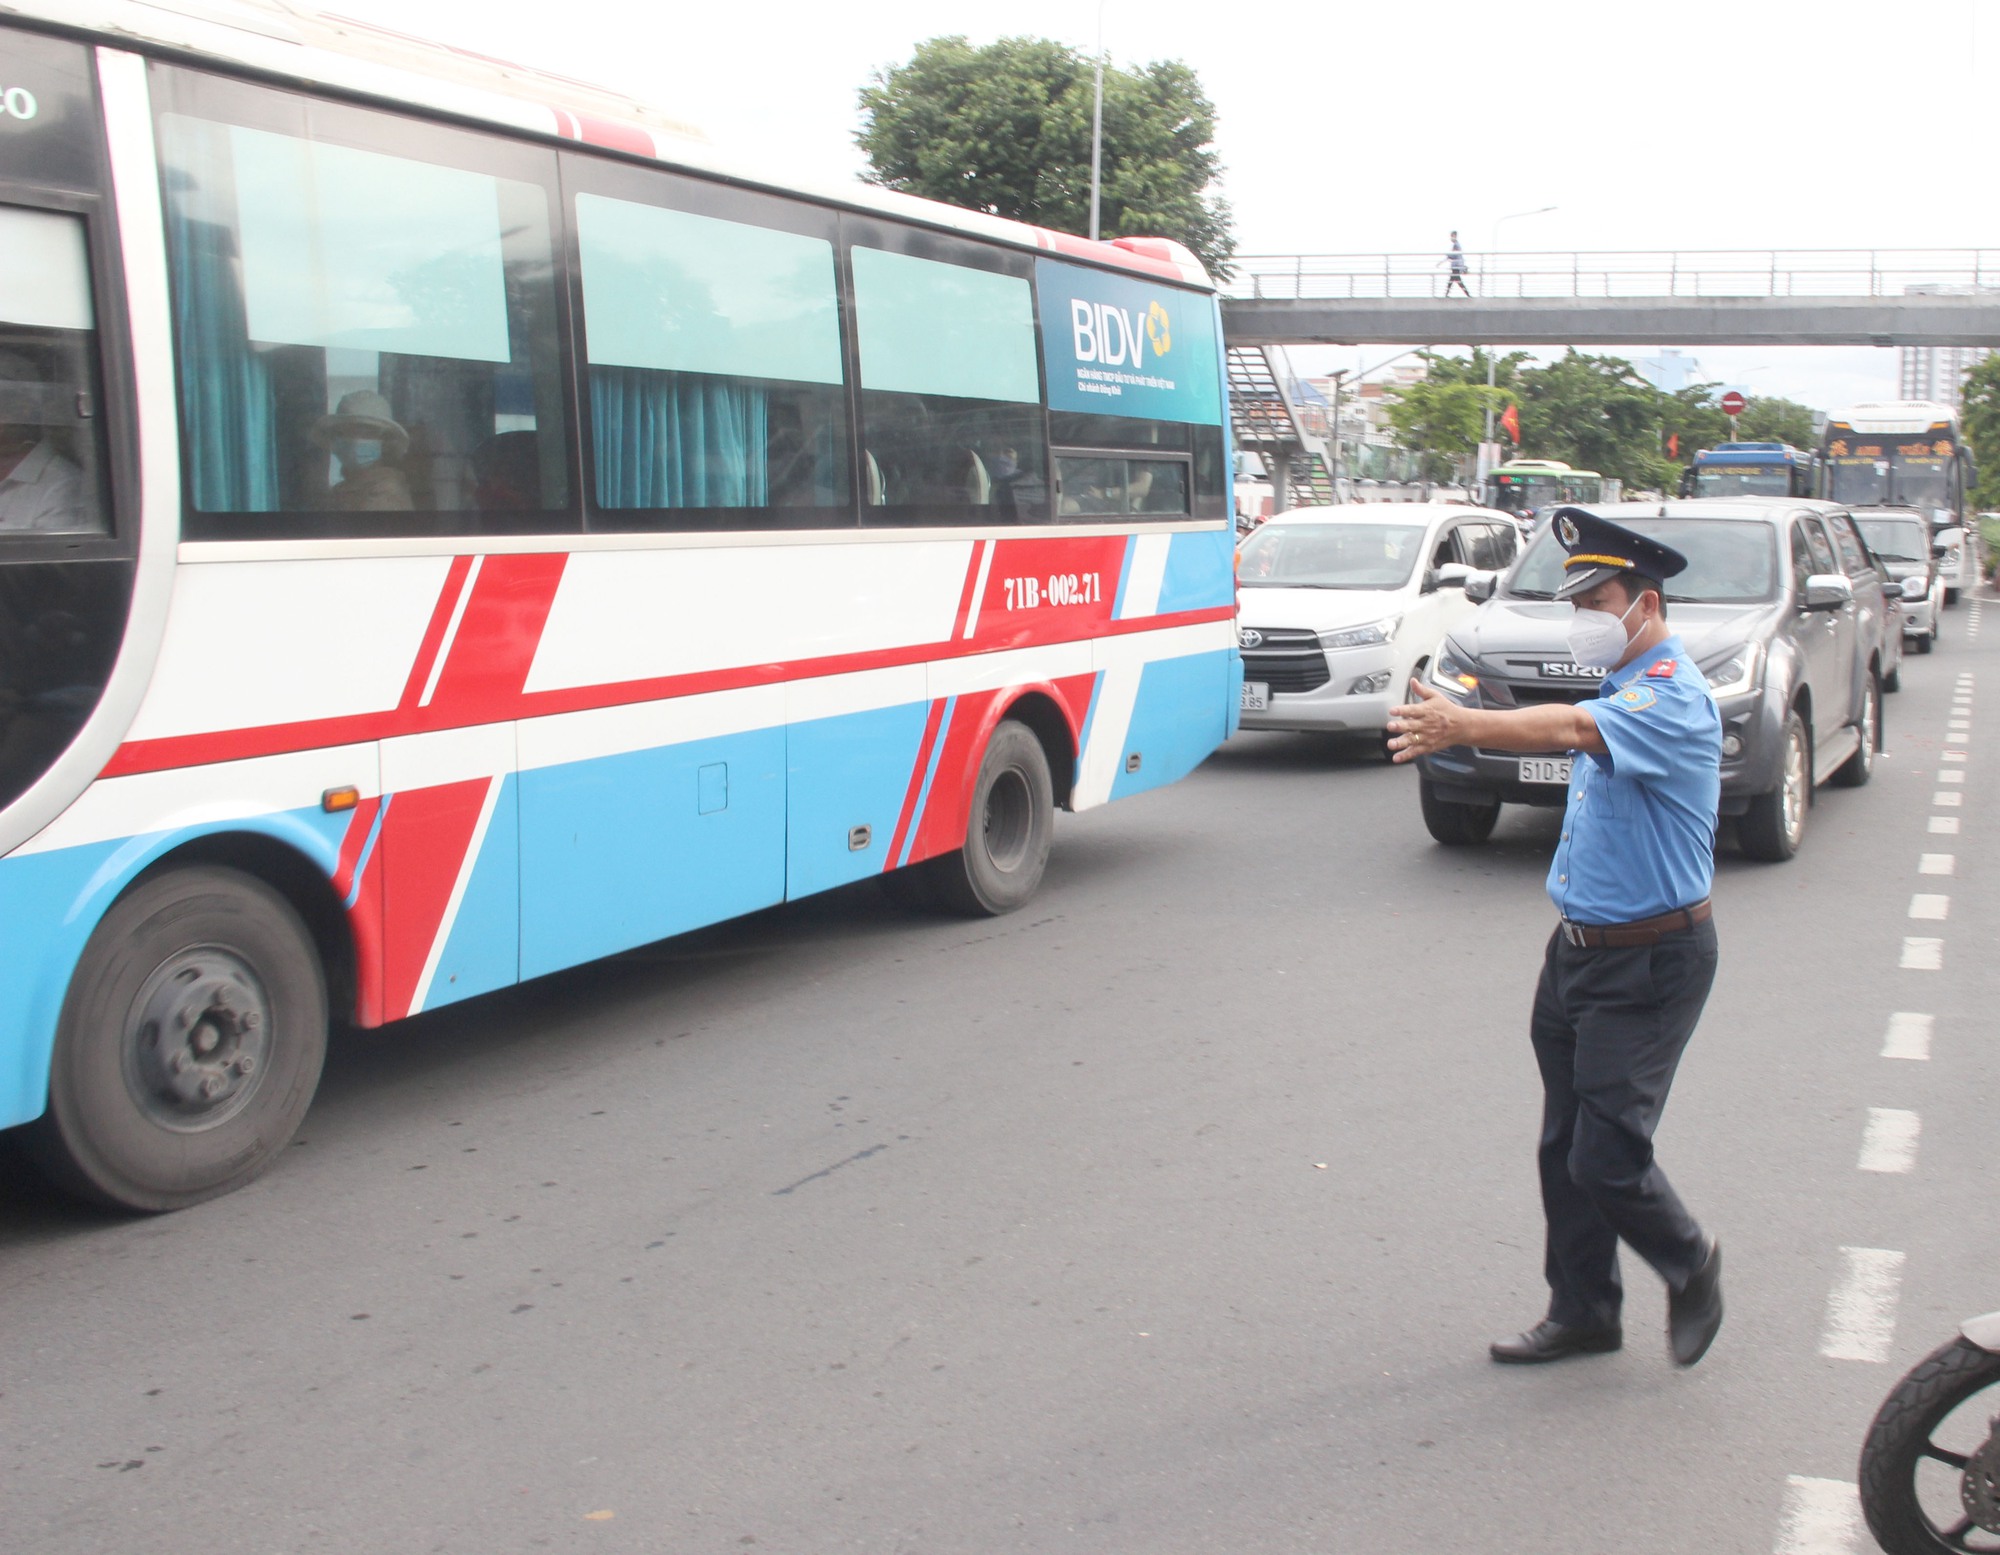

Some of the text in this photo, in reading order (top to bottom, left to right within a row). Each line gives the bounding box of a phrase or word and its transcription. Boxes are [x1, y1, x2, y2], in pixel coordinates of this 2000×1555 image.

[1071, 298, 1146, 369] BIDV
[1003, 572, 1101, 612] 71B-002.71
[1542, 662, 1607, 678] ISUZU
[1522, 761, 1573, 781] 51D-5
